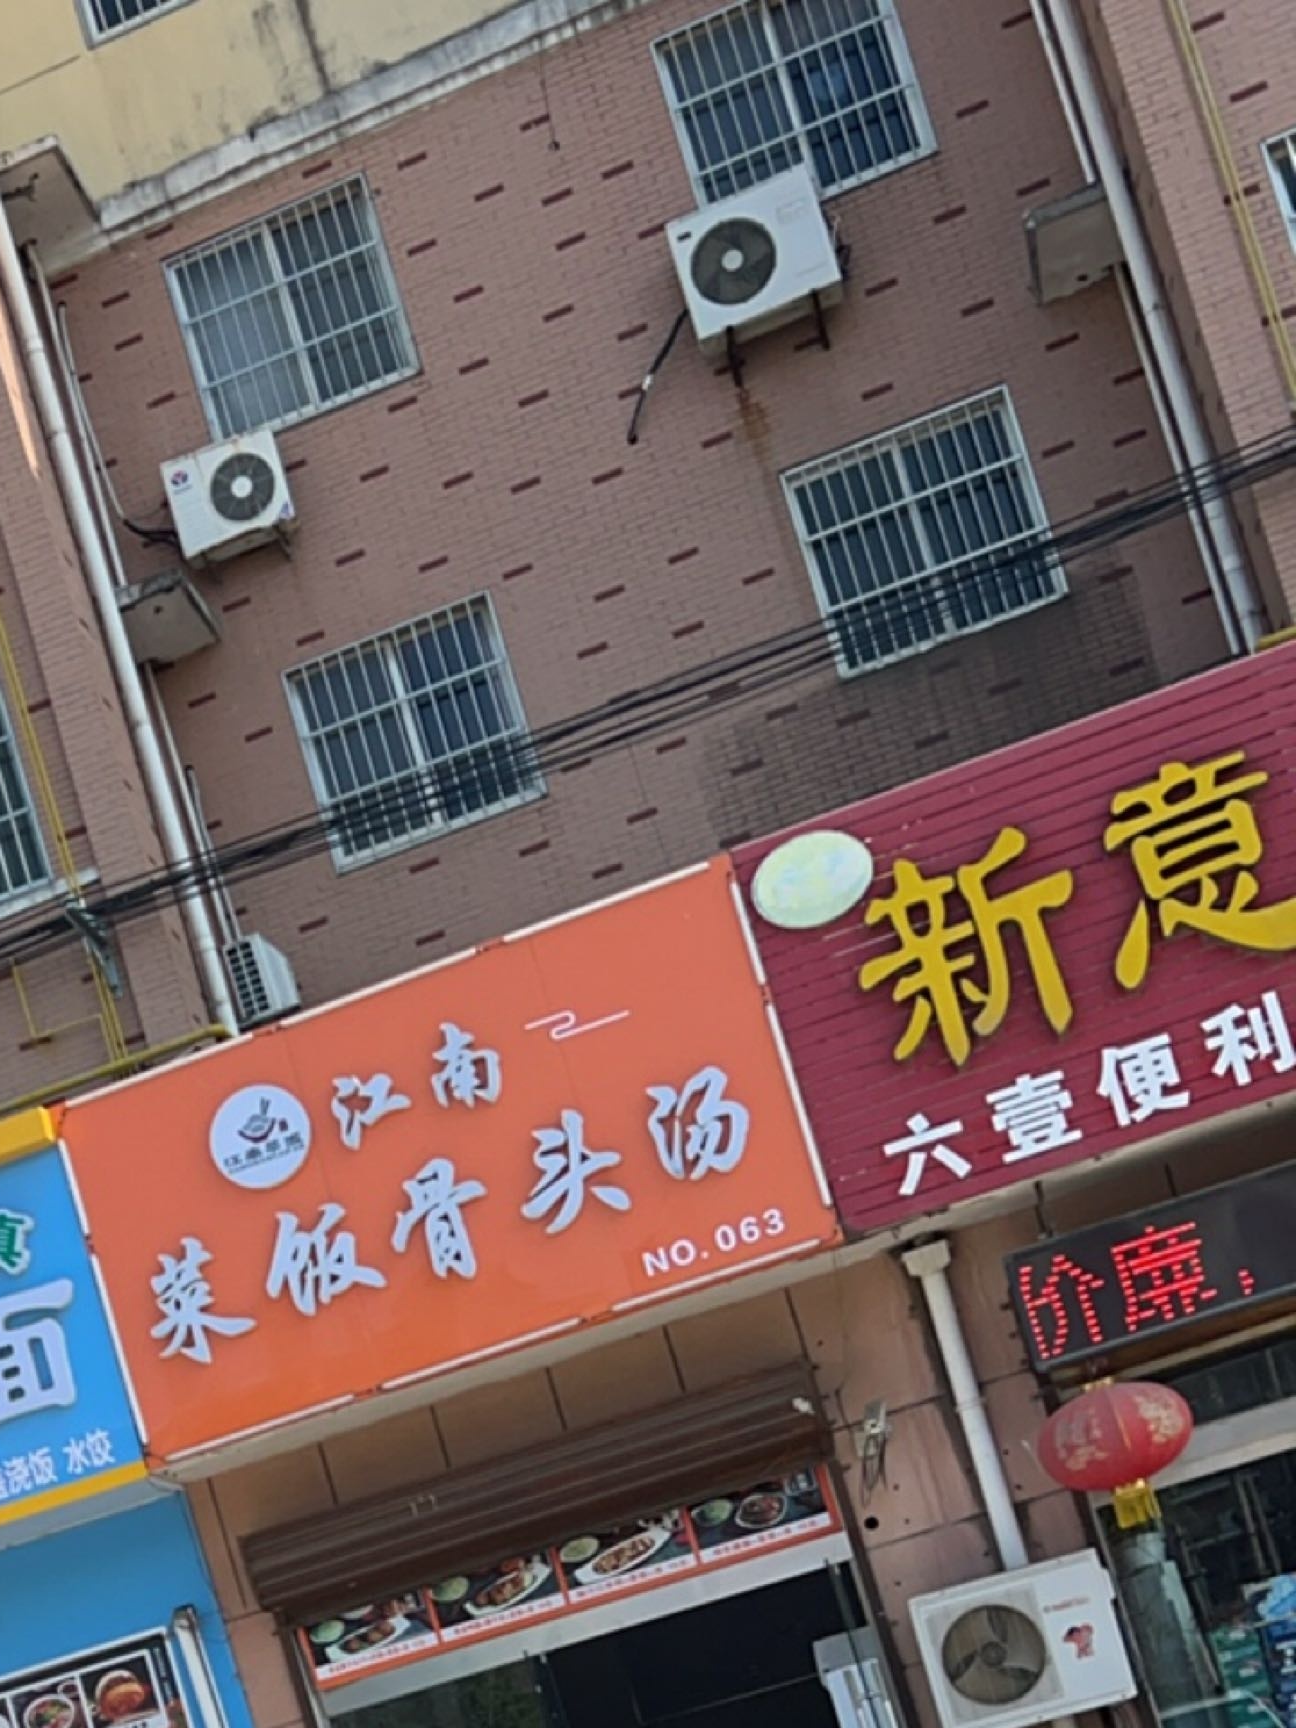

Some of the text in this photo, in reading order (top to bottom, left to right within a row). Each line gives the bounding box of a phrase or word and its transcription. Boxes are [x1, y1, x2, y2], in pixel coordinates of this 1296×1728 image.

[859, 751, 1296, 1067] 新意
[331, 1023, 503, 1150] 江南
[884, 991, 1296, 1195] 六壹便利
[150, 1066, 750, 1362] 菜饭骨头汤
[642, 1208, 786, 1277] NO.063
[63, 1428, 116, 1475] 水饺
